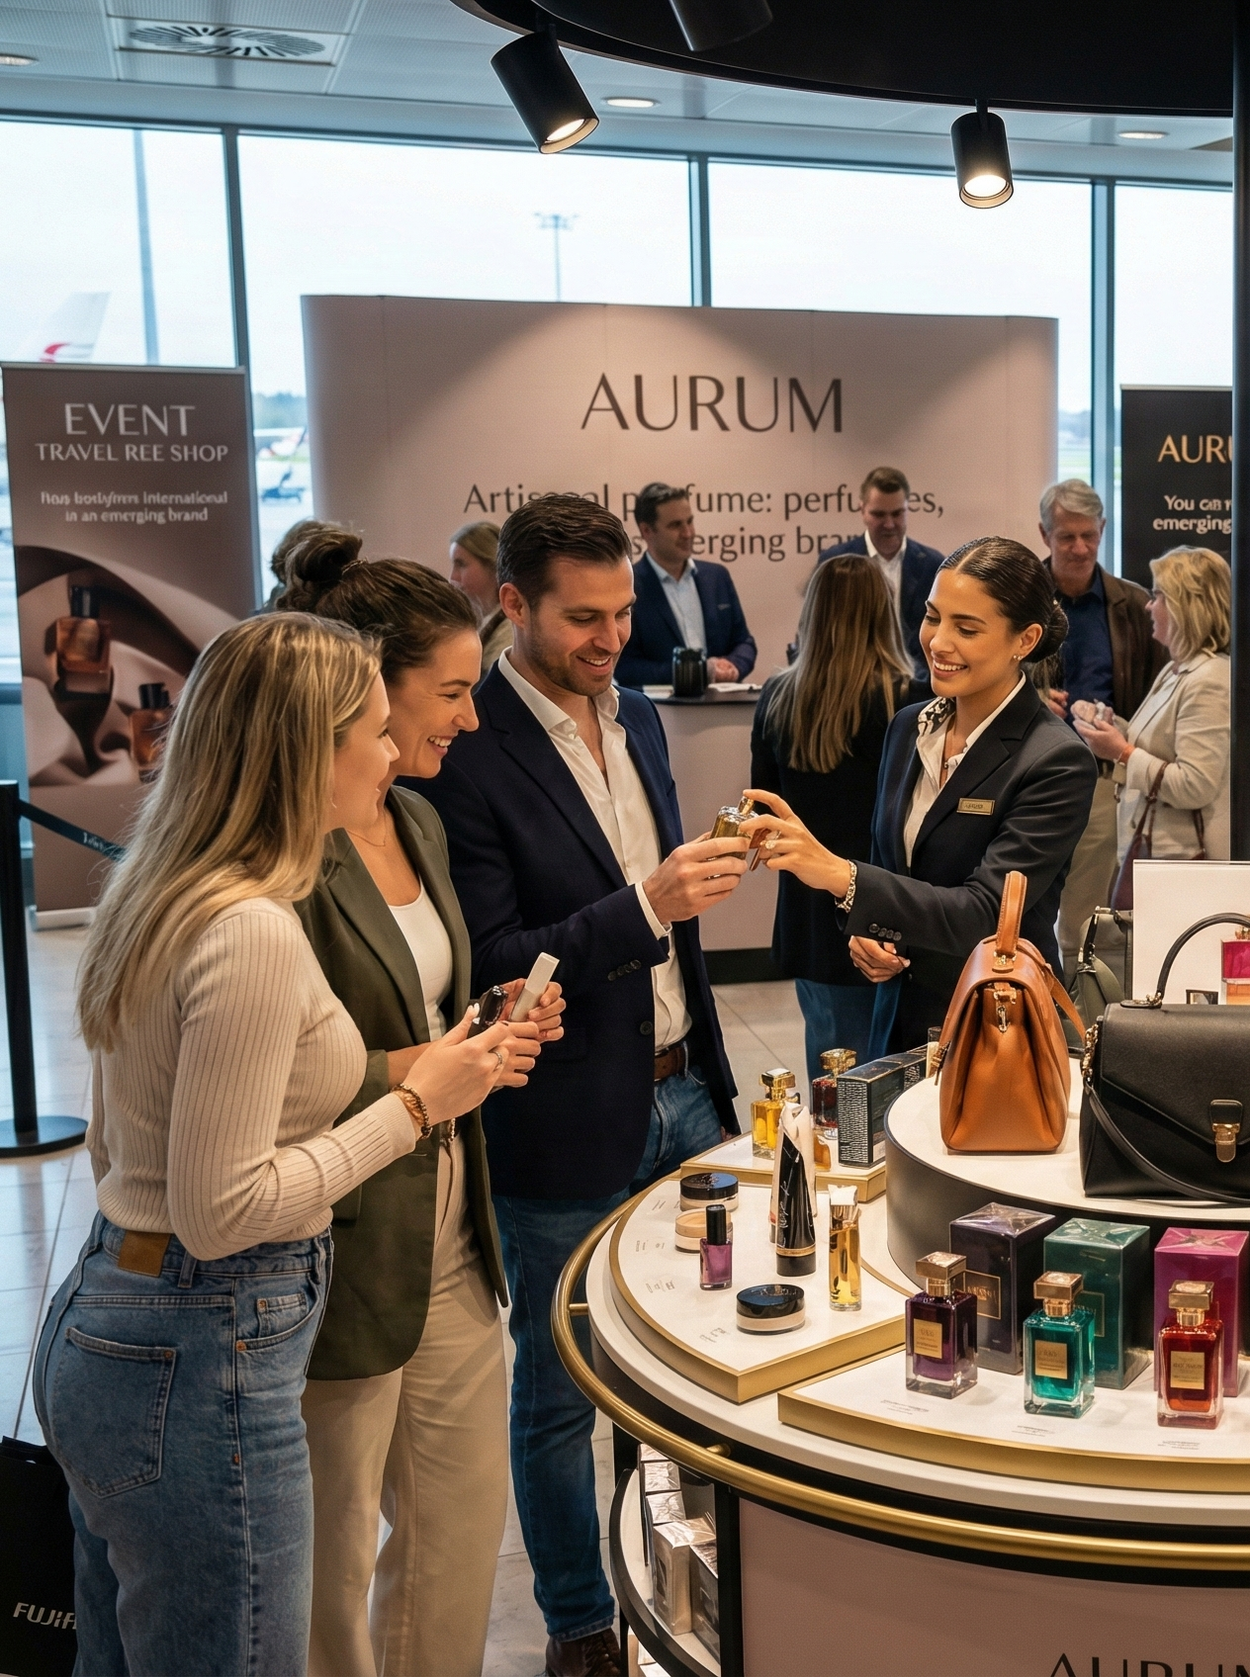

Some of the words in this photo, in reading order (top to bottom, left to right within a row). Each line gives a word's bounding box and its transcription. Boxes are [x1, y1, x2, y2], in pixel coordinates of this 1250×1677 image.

[580, 372, 842, 433] AURUM
[64, 403, 195, 436] EVENT
[35, 443, 119, 462] TRAVEL
[125, 443, 165, 462] REE
[170, 444, 229, 463] SHOP
[1157, 434, 1233, 464] AUR
[81, 510, 98, 522] an
[168, 507, 208, 521] brand
[784, 484, 945, 521] perfues,
[1163, 495, 1196, 511] You
[1152, 515, 1232, 534] emerging
[691, 527, 786, 563] erging
[12, 1602, 77, 1630] FUJIF
